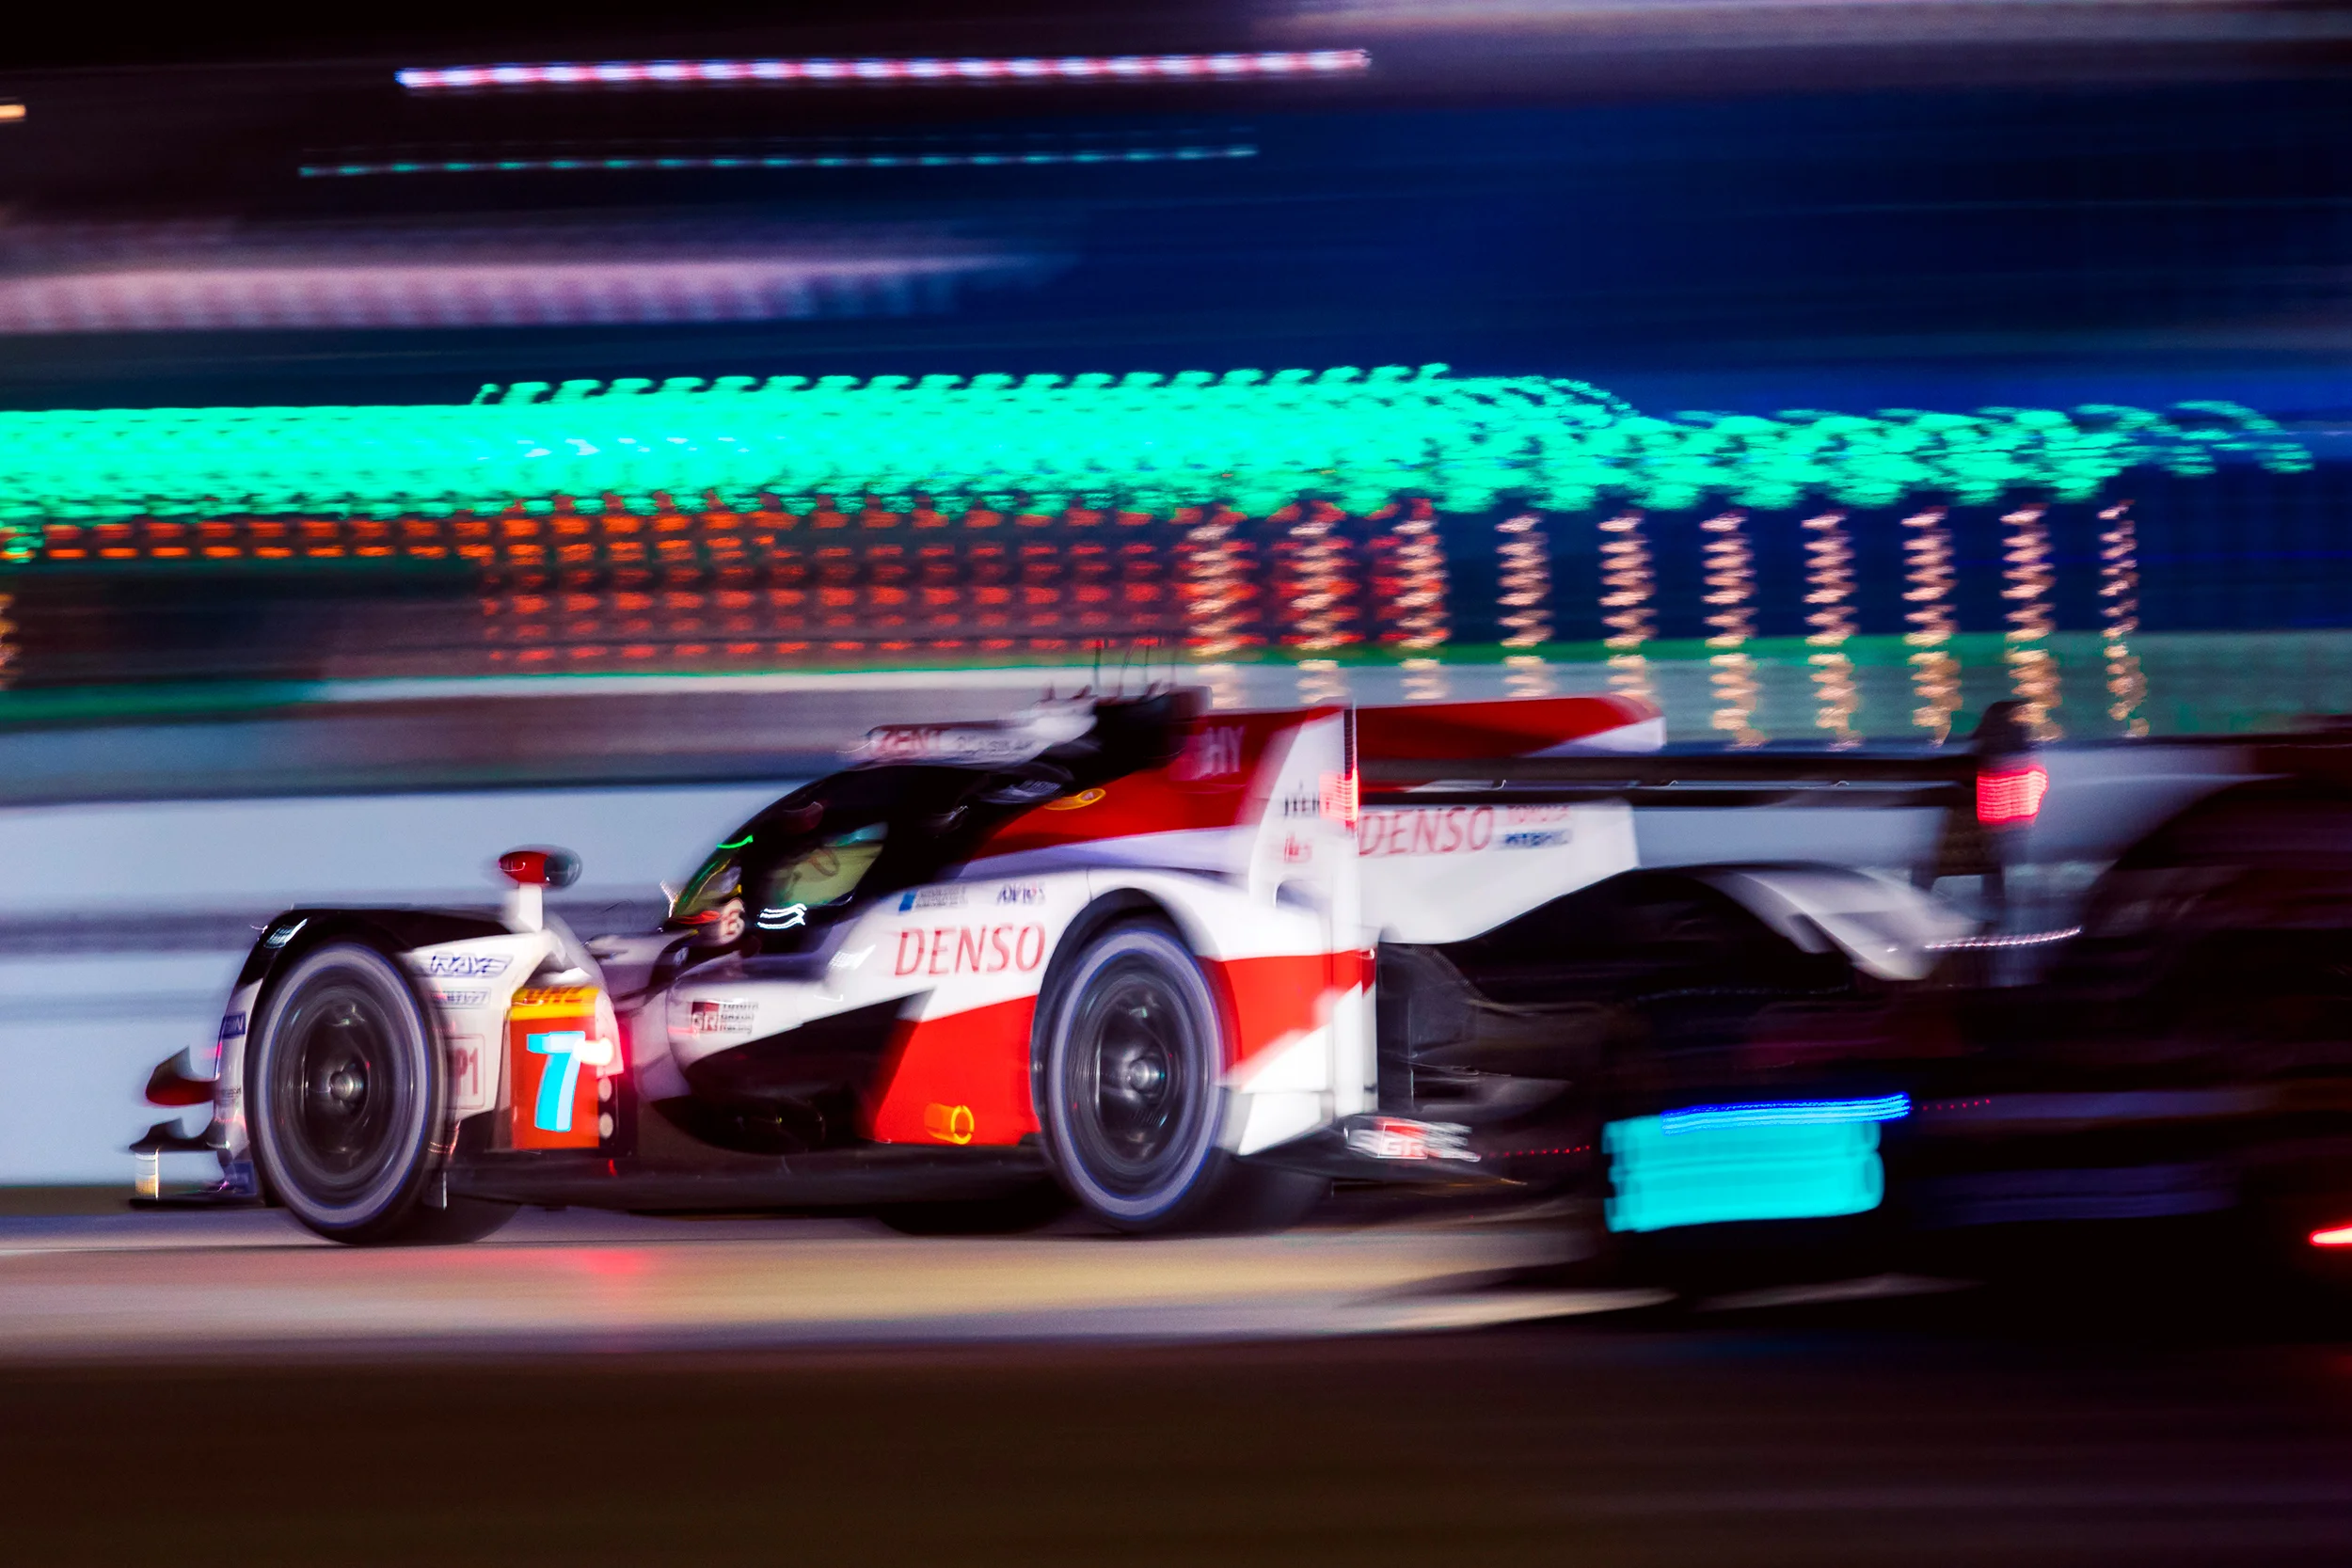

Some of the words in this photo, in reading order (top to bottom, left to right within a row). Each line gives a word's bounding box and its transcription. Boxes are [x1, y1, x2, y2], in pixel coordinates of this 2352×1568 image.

[1359, 805, 1494, 856] DENSO
[894, 921, 1046, 976] DENSO
[526, 1031, 586, 1132] 7
